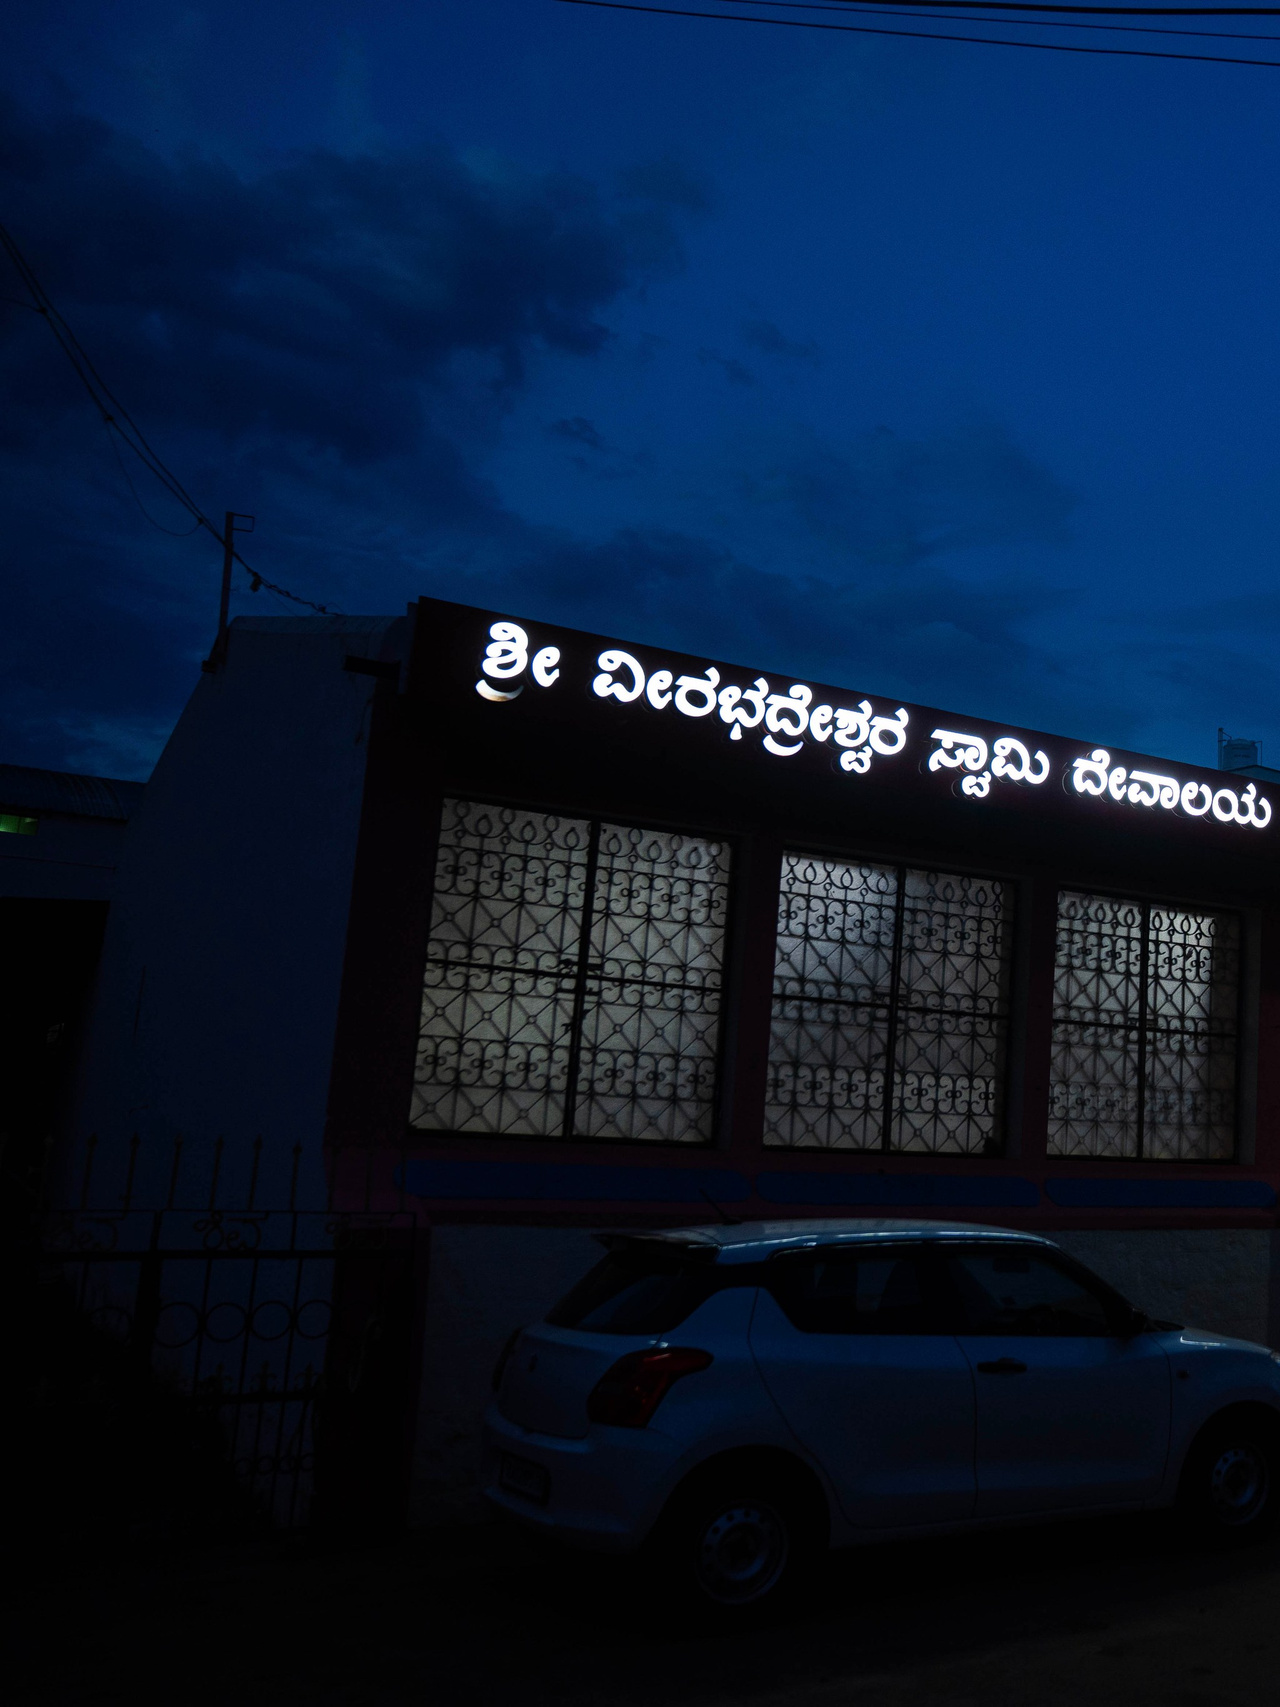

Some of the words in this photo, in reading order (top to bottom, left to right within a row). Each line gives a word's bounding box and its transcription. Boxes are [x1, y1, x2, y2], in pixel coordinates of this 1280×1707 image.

[476, 622, 560, 702] ಶ್ರೀ
[592, 649, 909, 775] ವೀರಭದ್ರೇಶ್ವರ
[929, 729, 1049, 798] ಸ್ವಾಮಿ
[1073, 748, 1271, 829] ದೇವಾಲಯ
